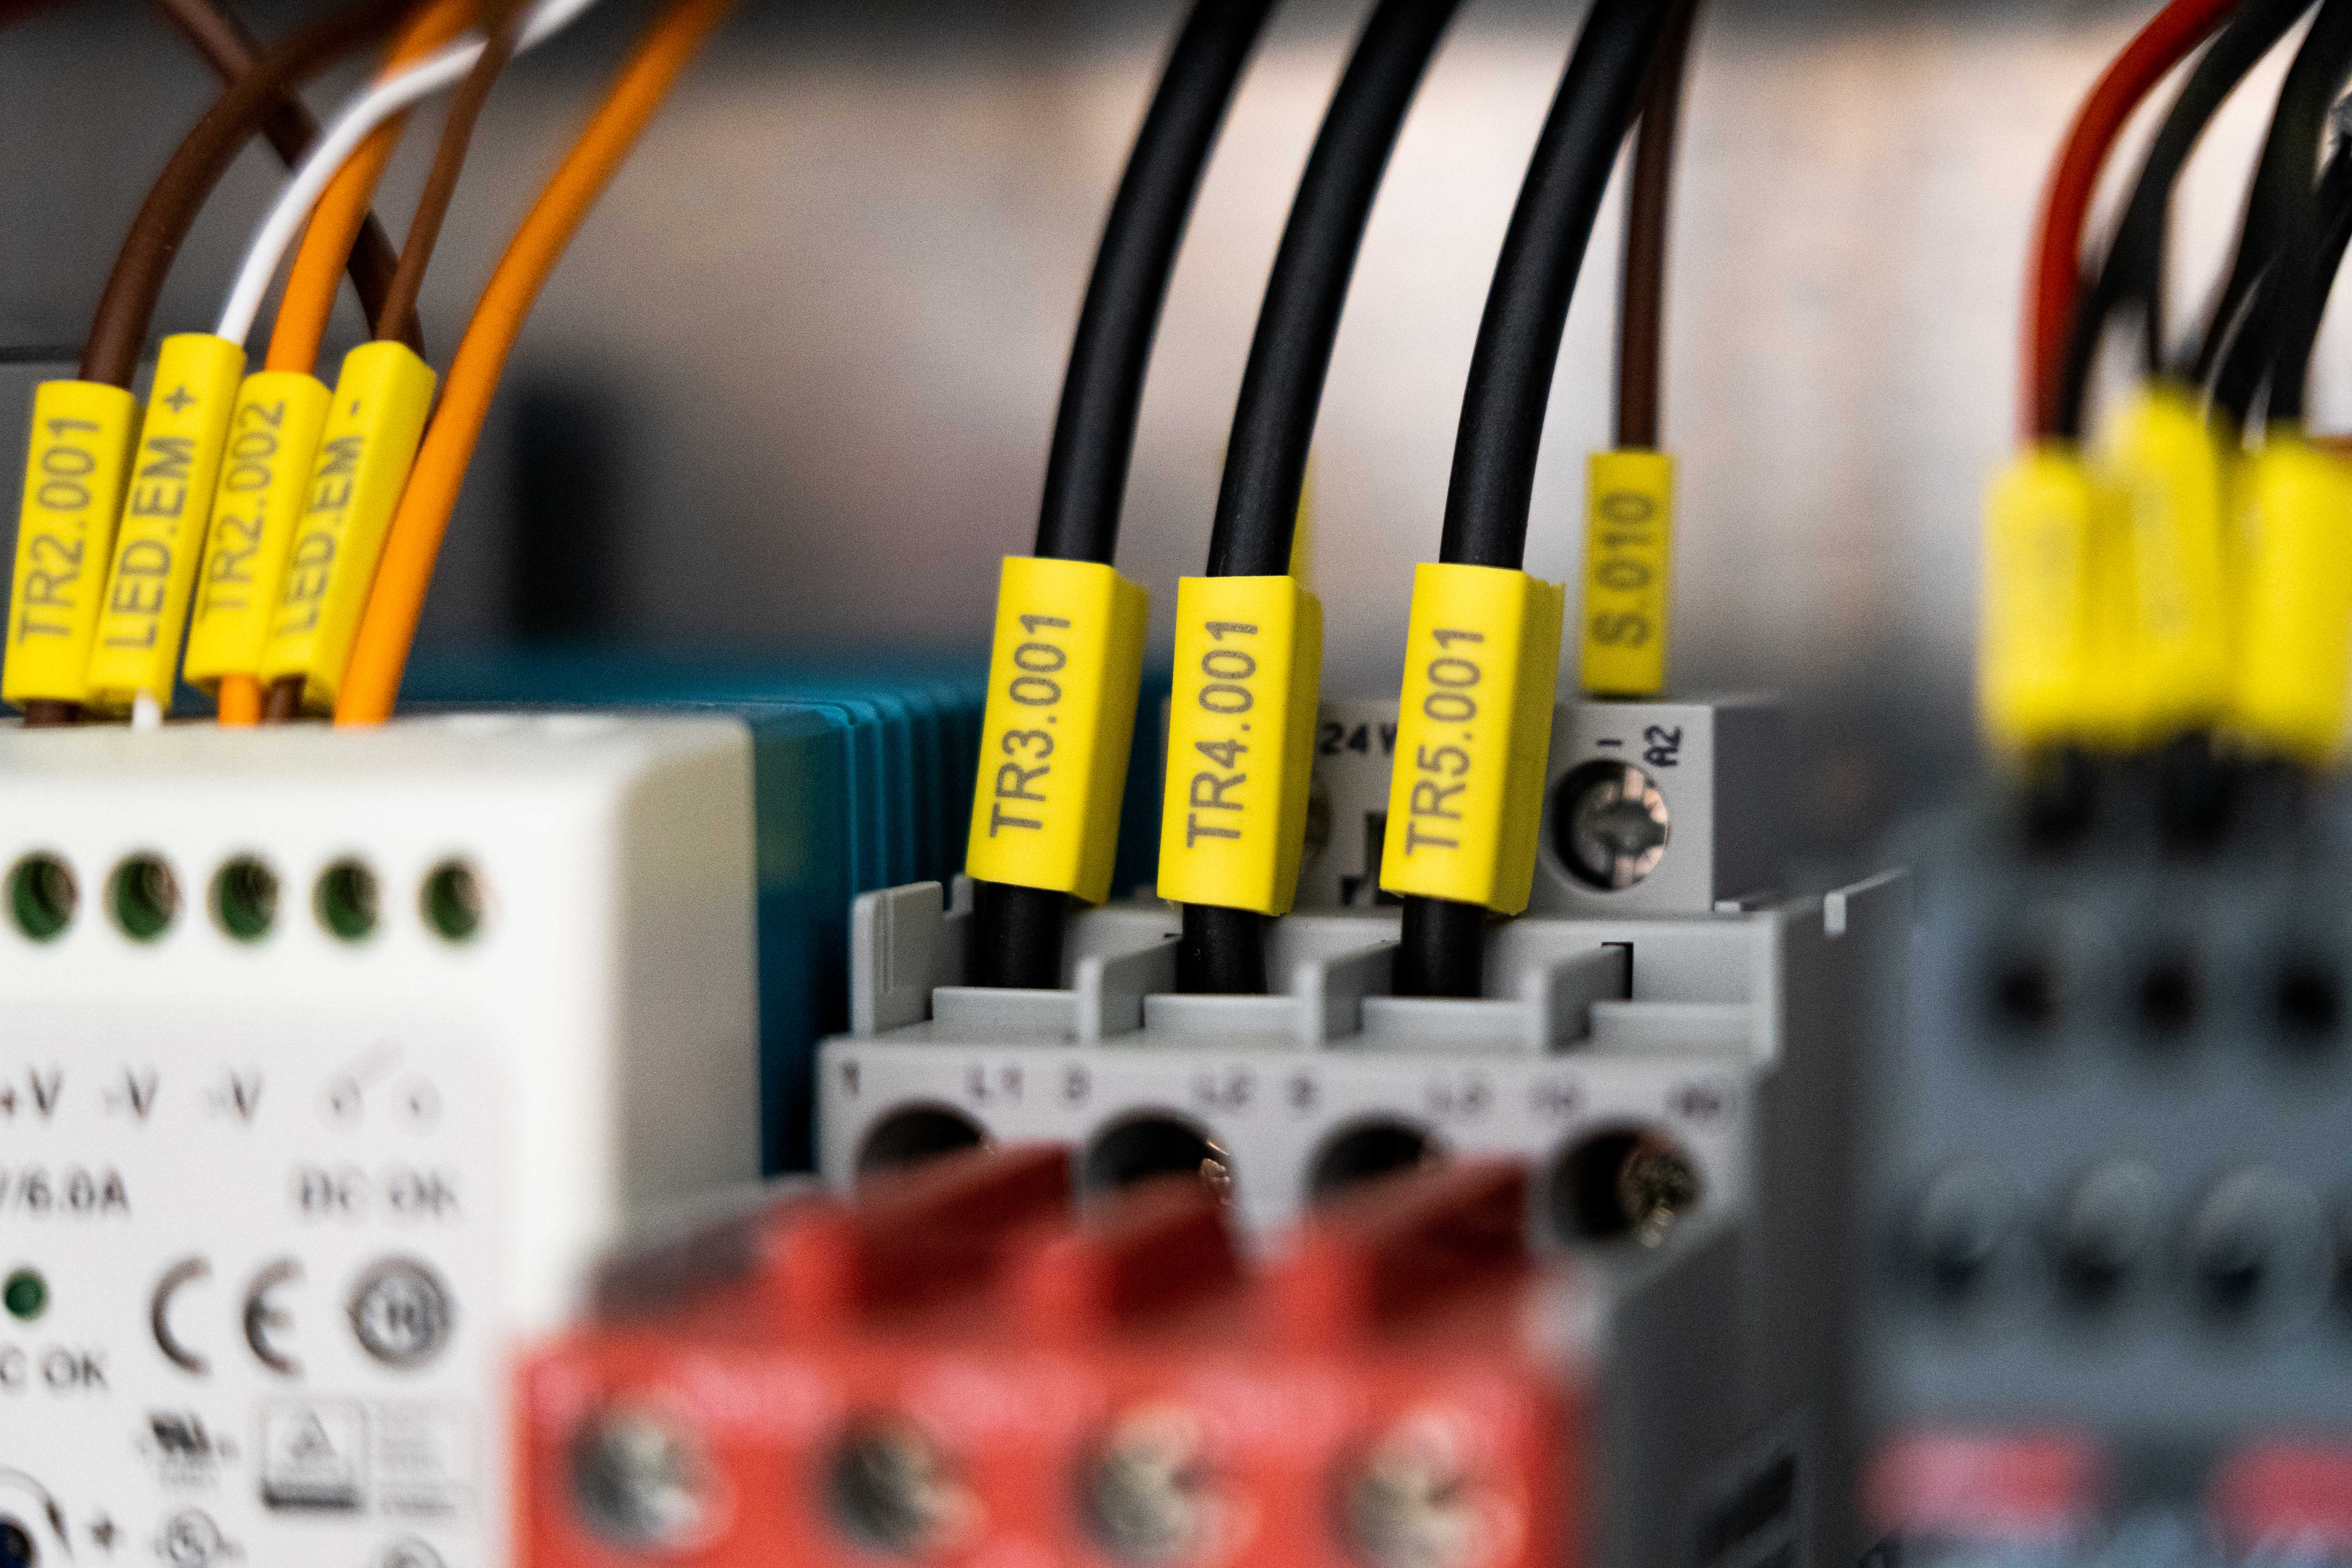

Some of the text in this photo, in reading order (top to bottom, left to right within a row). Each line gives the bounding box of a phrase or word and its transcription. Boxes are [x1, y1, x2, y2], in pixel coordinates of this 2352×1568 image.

[16, 417, 100, 643] TR2.001
[104, 436, 195, 649] LED.EM
[199, 399, 286, 621] TR2.002
[278, 435, 364, 637] LED.EM
[990, 614, 1071, 838] TR3.001
[1187, 621, 1258, 848] TR4.001
[1405, 628, 1485, 856] TR5.001
[1644, 725, 1681, 767] A2
